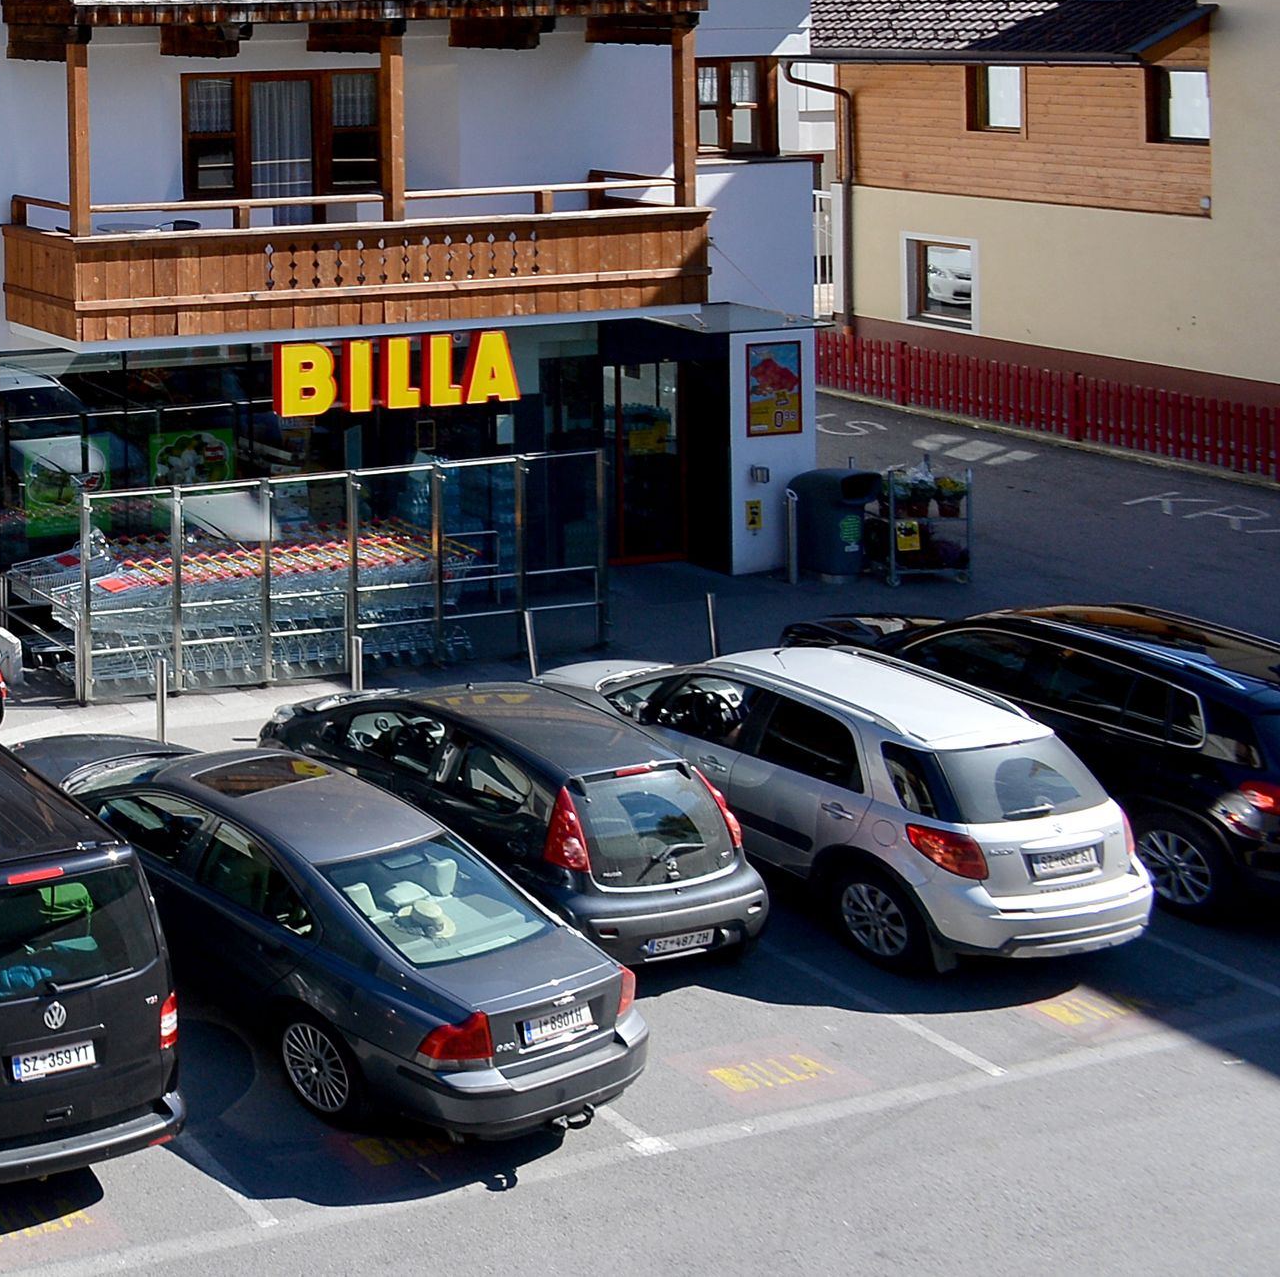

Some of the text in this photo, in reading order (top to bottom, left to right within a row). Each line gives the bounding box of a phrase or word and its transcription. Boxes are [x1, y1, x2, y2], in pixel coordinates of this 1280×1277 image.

[273, 330, 521, 417] BILLA
[655, 939, 668, 952] SZ
[695, 931, 709, 944] ZH
[22, 1044, 91, 1073] SZ 359 YT
[707, 1052, 836, 1093] BILLA
